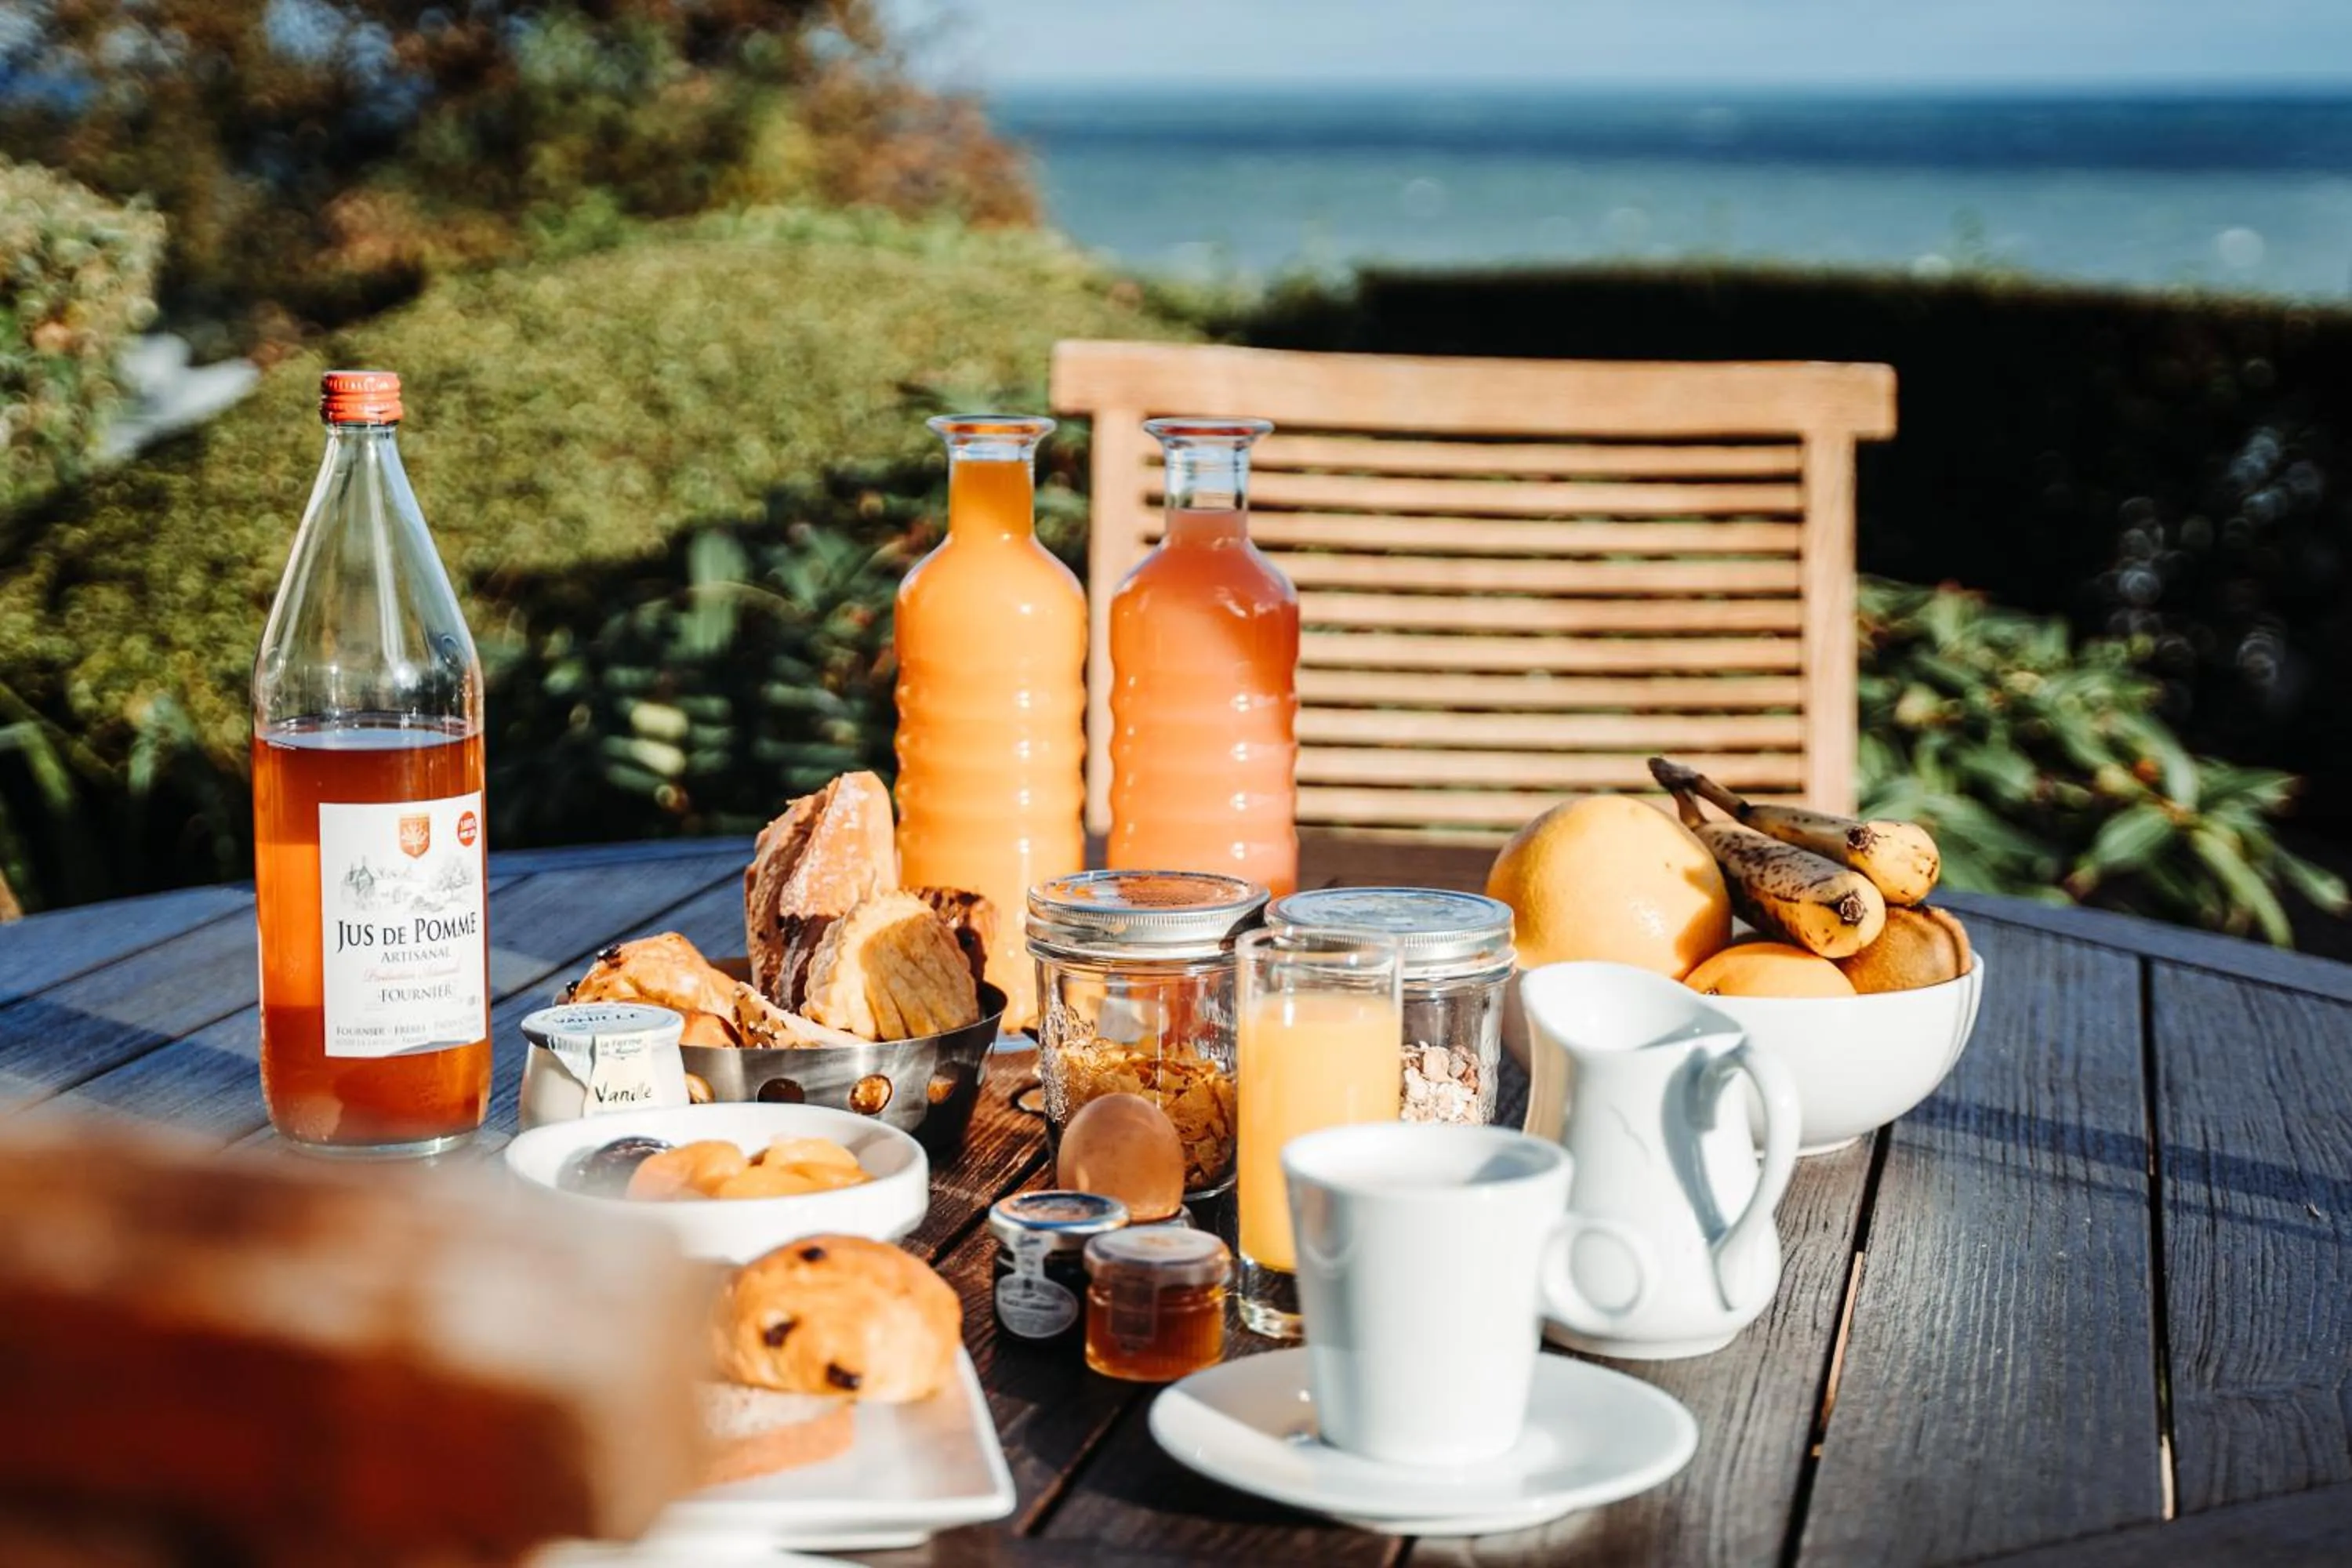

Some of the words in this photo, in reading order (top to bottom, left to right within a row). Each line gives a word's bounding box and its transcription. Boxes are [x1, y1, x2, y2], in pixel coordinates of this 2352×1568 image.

[337, 920, 374, 953] JUS
[383, 926, 407, 946] DE
[415, 912, 477, 944] POMME
[380, 946, 451, 964] ARTISANAL
[381, 983, 452, 1004] FOURNIER
[594, 1080, 653, 1104] Vanille
